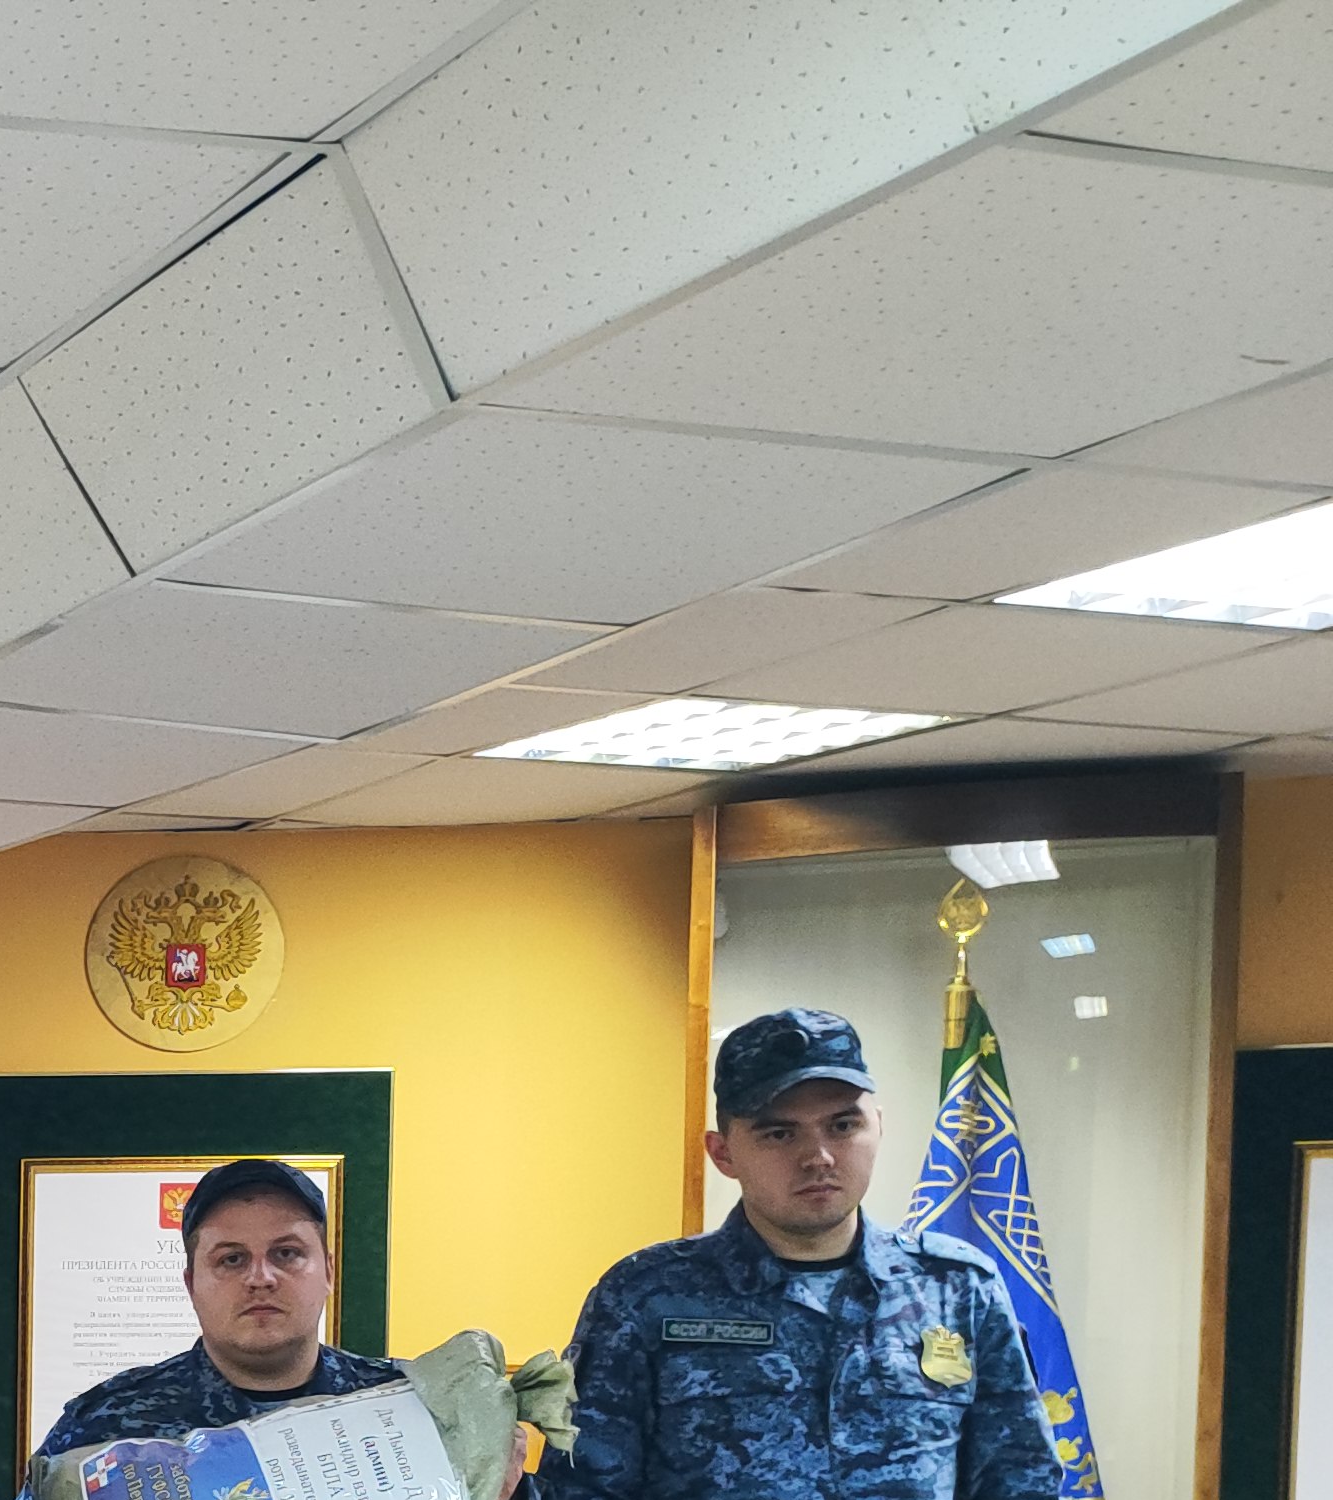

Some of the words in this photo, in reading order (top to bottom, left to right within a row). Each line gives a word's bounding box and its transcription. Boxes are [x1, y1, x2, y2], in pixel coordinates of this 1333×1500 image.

[62, 1261, 137, 1270] ПРЕЗИДЕНТА
[157, 1240, 187, 1254] УК
[714, 1323, 766, 1340] РОССИИ
[330, 1418, 361, 1478] командир
[359, 1435, 395, 1493] (админ)
[374, 1409, 395, 1429] Для
[387, 1430, 414, 1482] Лыкова
[317, 1453, 344, 1498] БПЛА
